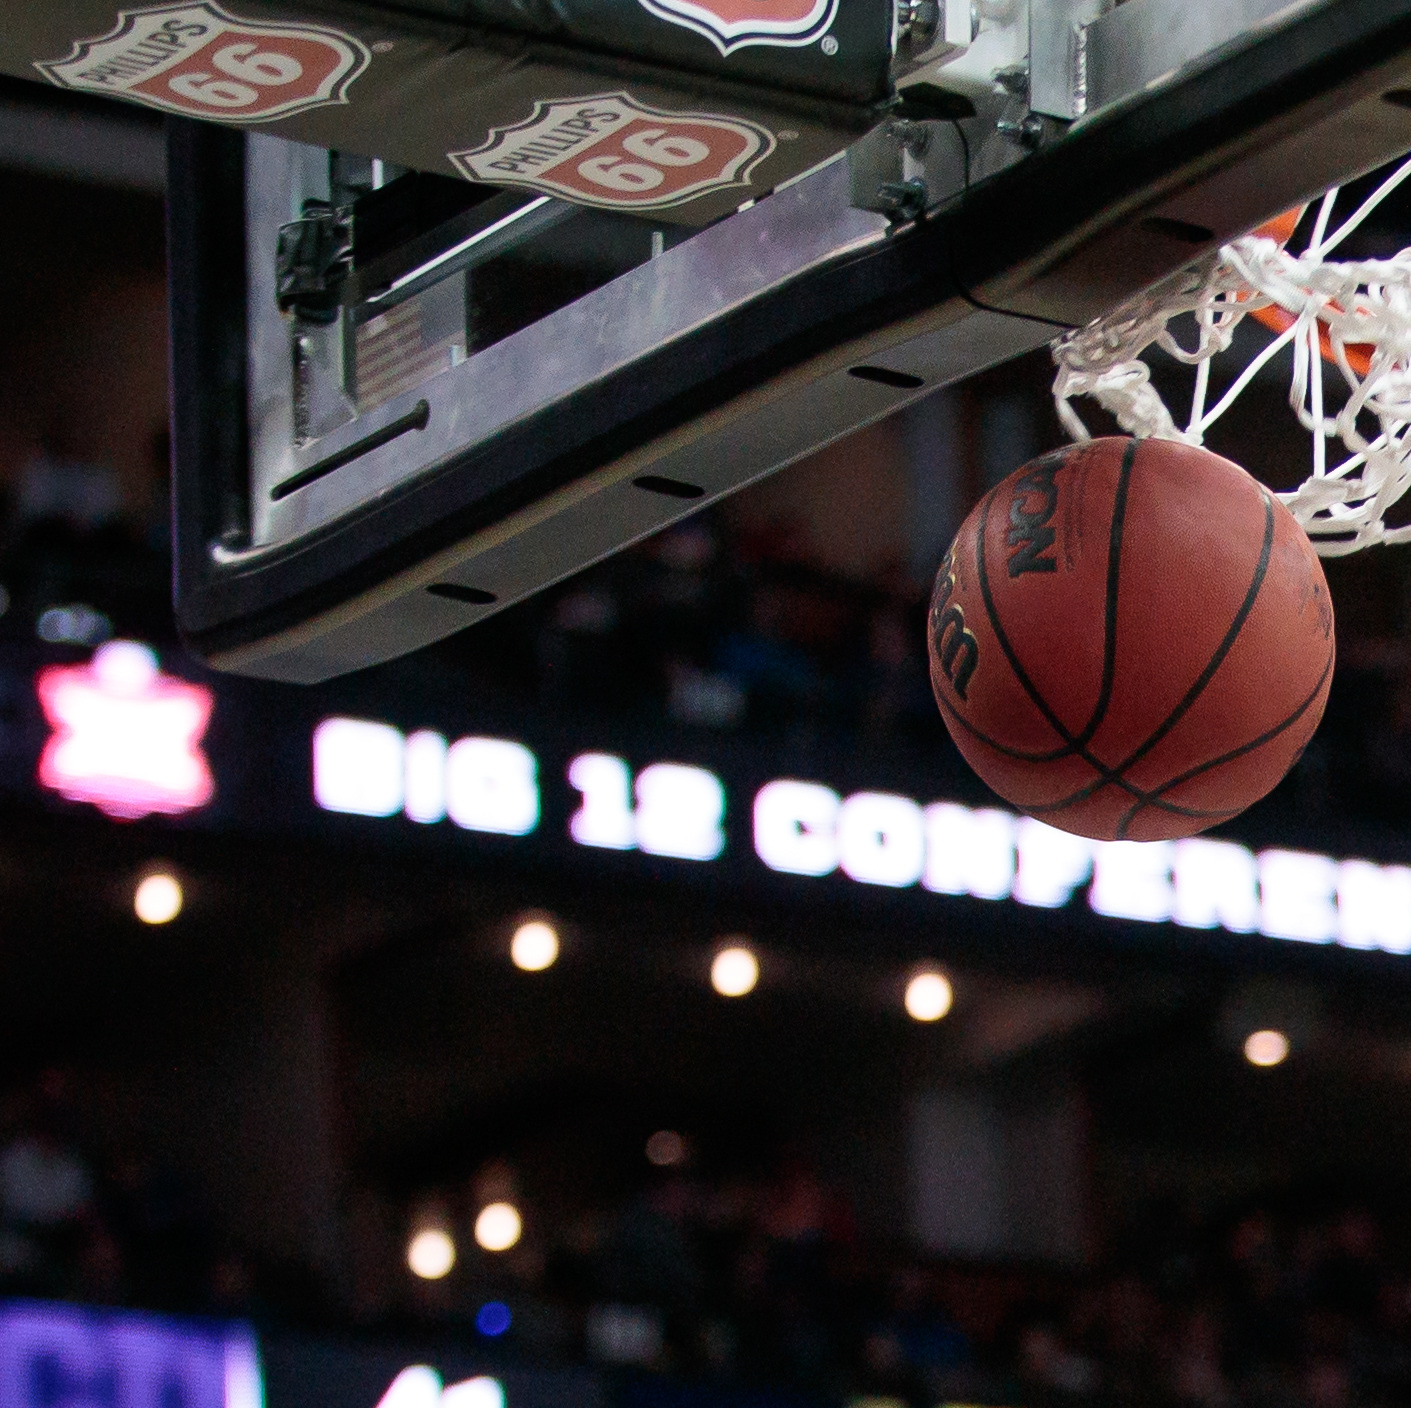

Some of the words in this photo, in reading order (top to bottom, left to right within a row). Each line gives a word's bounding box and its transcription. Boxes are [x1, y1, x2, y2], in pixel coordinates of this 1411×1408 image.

[76, 19, 208, 85] PHILLIPS
[168, 42, 303, 107] 66
[488, 107, 620, 174] PHILLIPS
[577, 129, 710, 192] 66
[312, 716, 541, 836] BIG
[568, 750, 727, 861] 12
